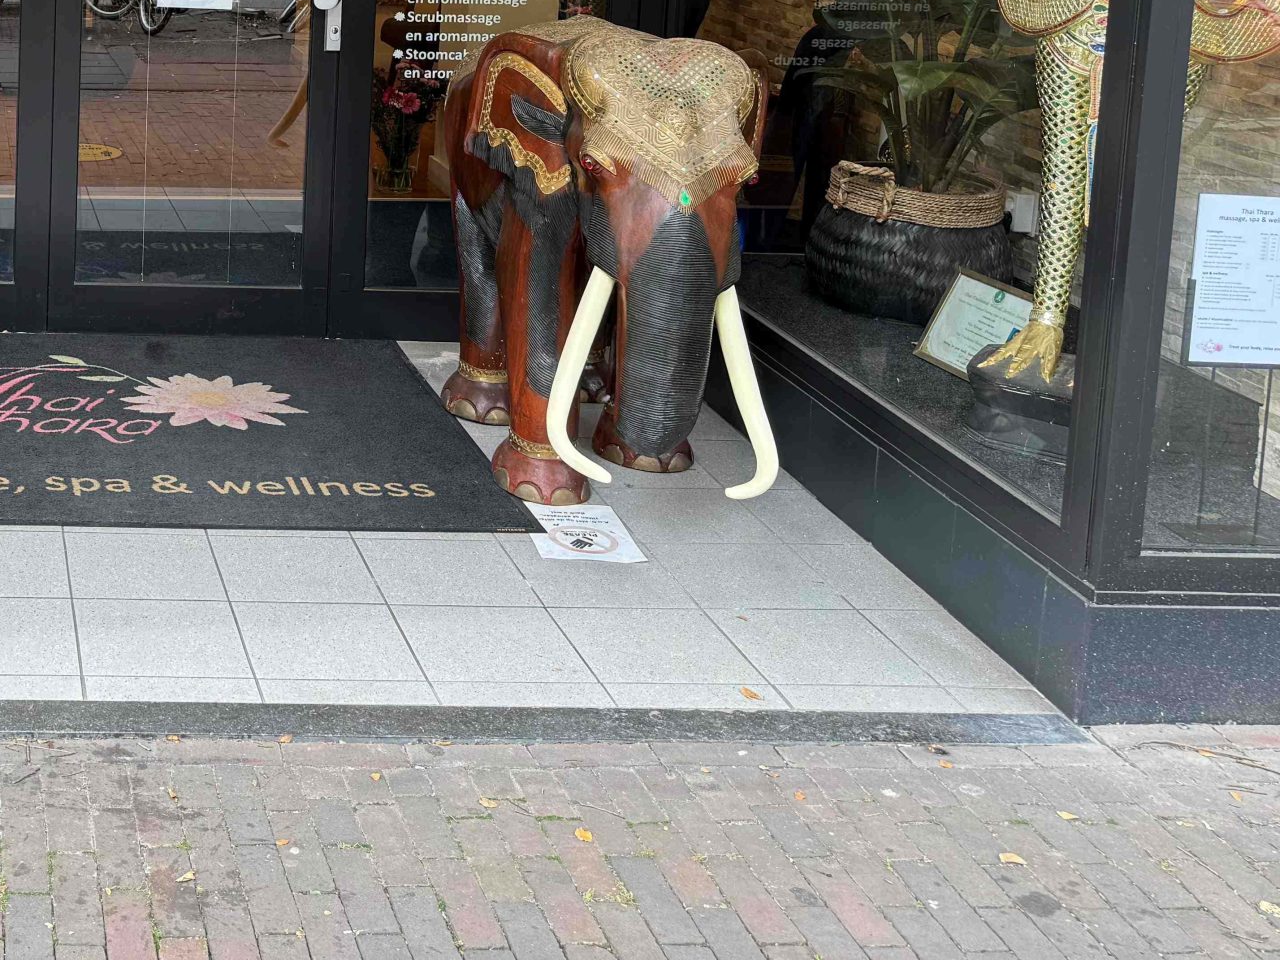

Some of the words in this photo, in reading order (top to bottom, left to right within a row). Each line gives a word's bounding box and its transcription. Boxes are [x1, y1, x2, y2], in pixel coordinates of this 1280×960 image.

[407, 11, 501, 25] Scrubmassage
[405, 32, 422, 41] en
[426, 32, 500, 42] aromamas
[404, 70, 420, 79] en
[45, 475, 131, 496] spa
[151, 474, 193, 494] &
[207, 476, 436, 497] wellness
